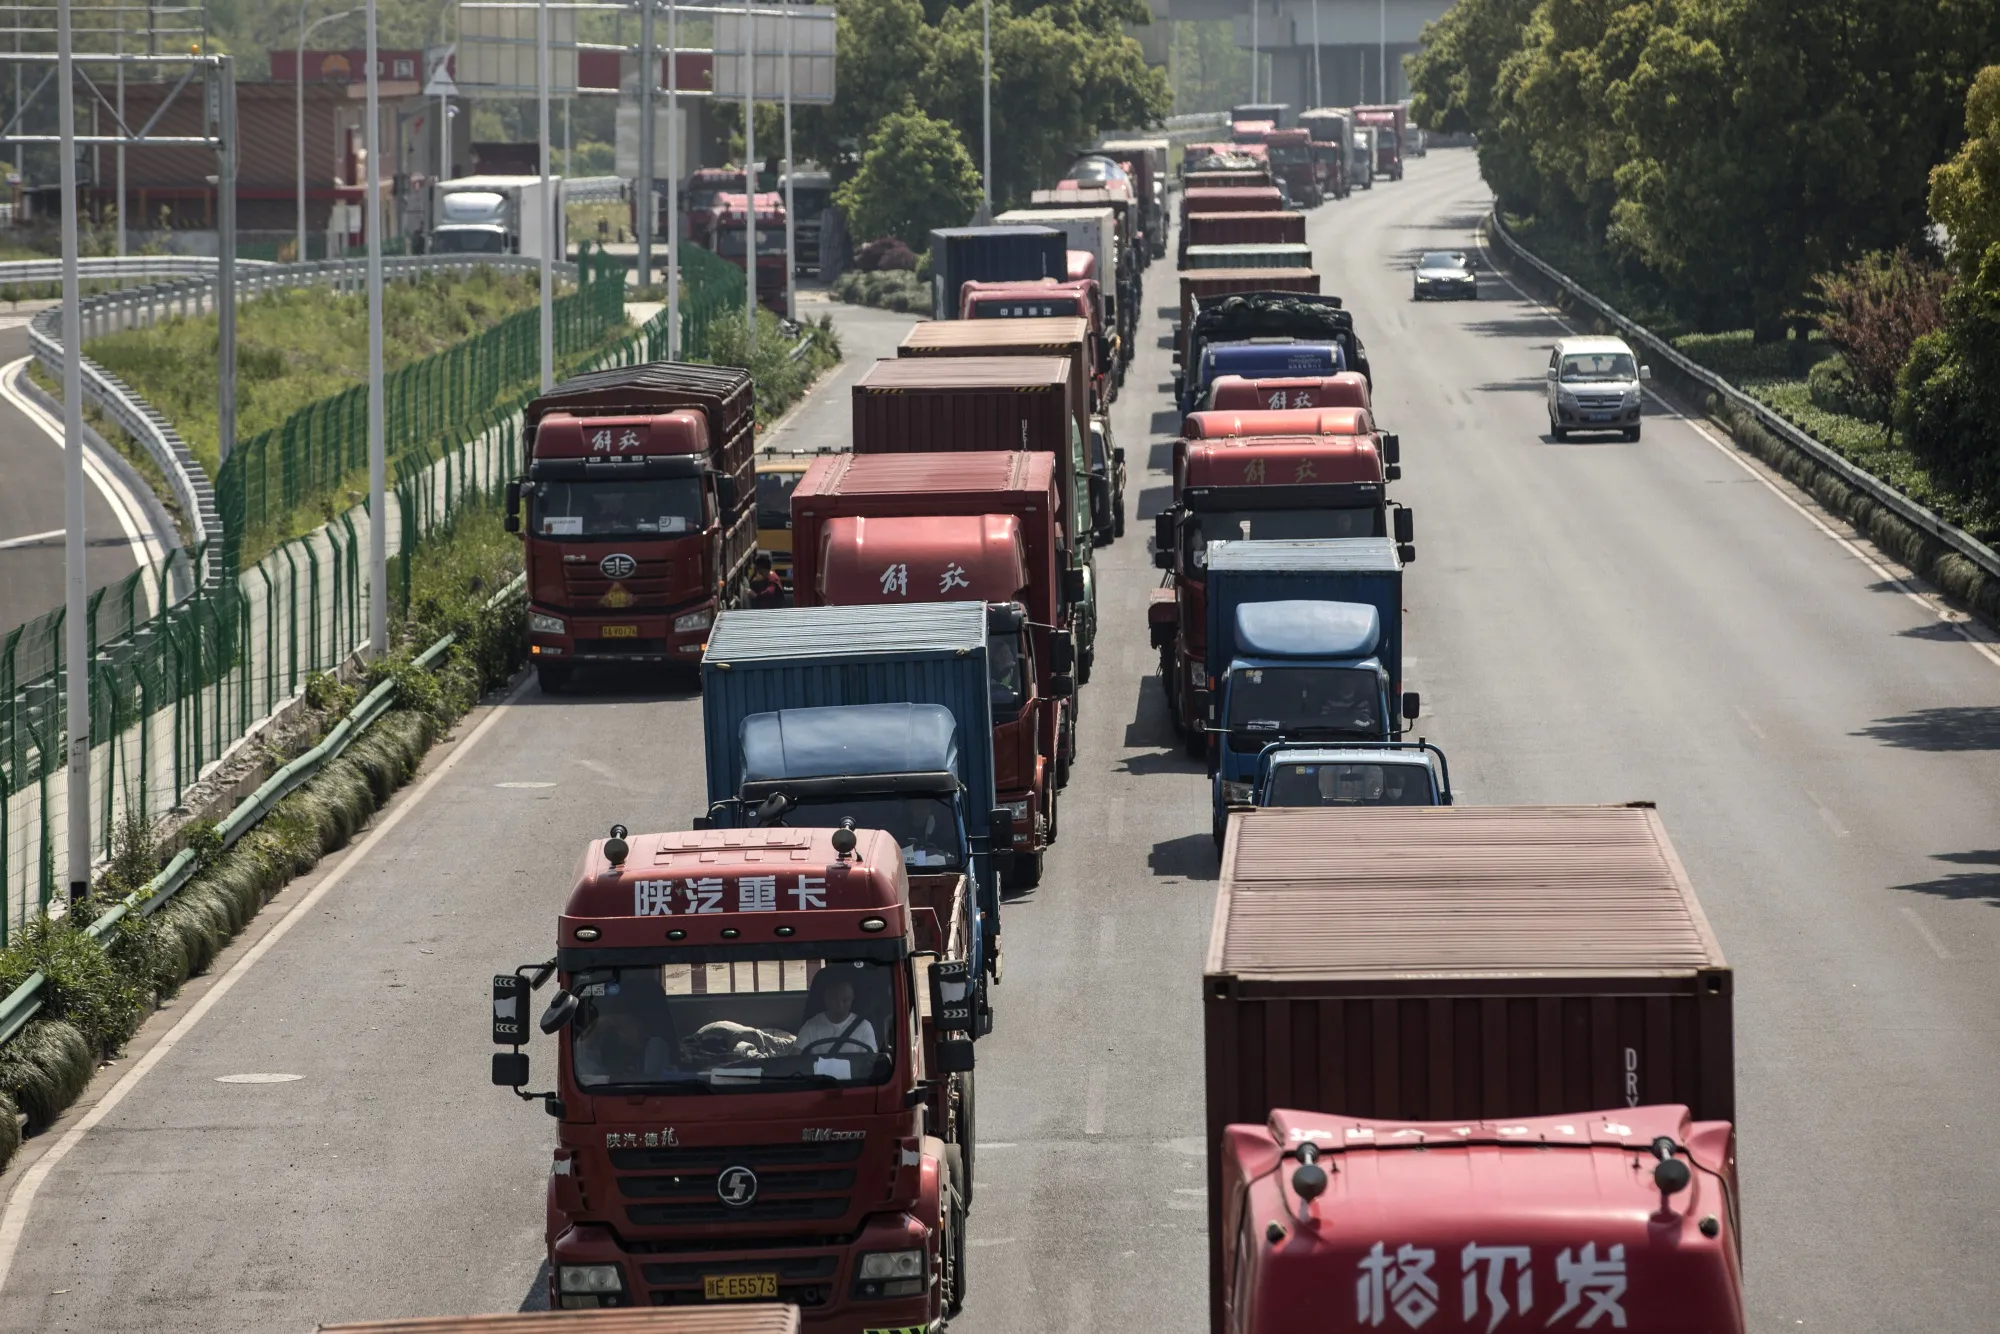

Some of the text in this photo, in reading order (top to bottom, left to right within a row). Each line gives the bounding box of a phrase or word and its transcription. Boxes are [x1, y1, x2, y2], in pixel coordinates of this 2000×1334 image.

[591, 429, 640, 452] 解放
[1244, 458, 1317, 484] 解放
[880, 562, 970, 596] 解放
[634, 875, 827, 916] 陕汽重卡
[1356, 1241, 1628, 1334] 格尔发
